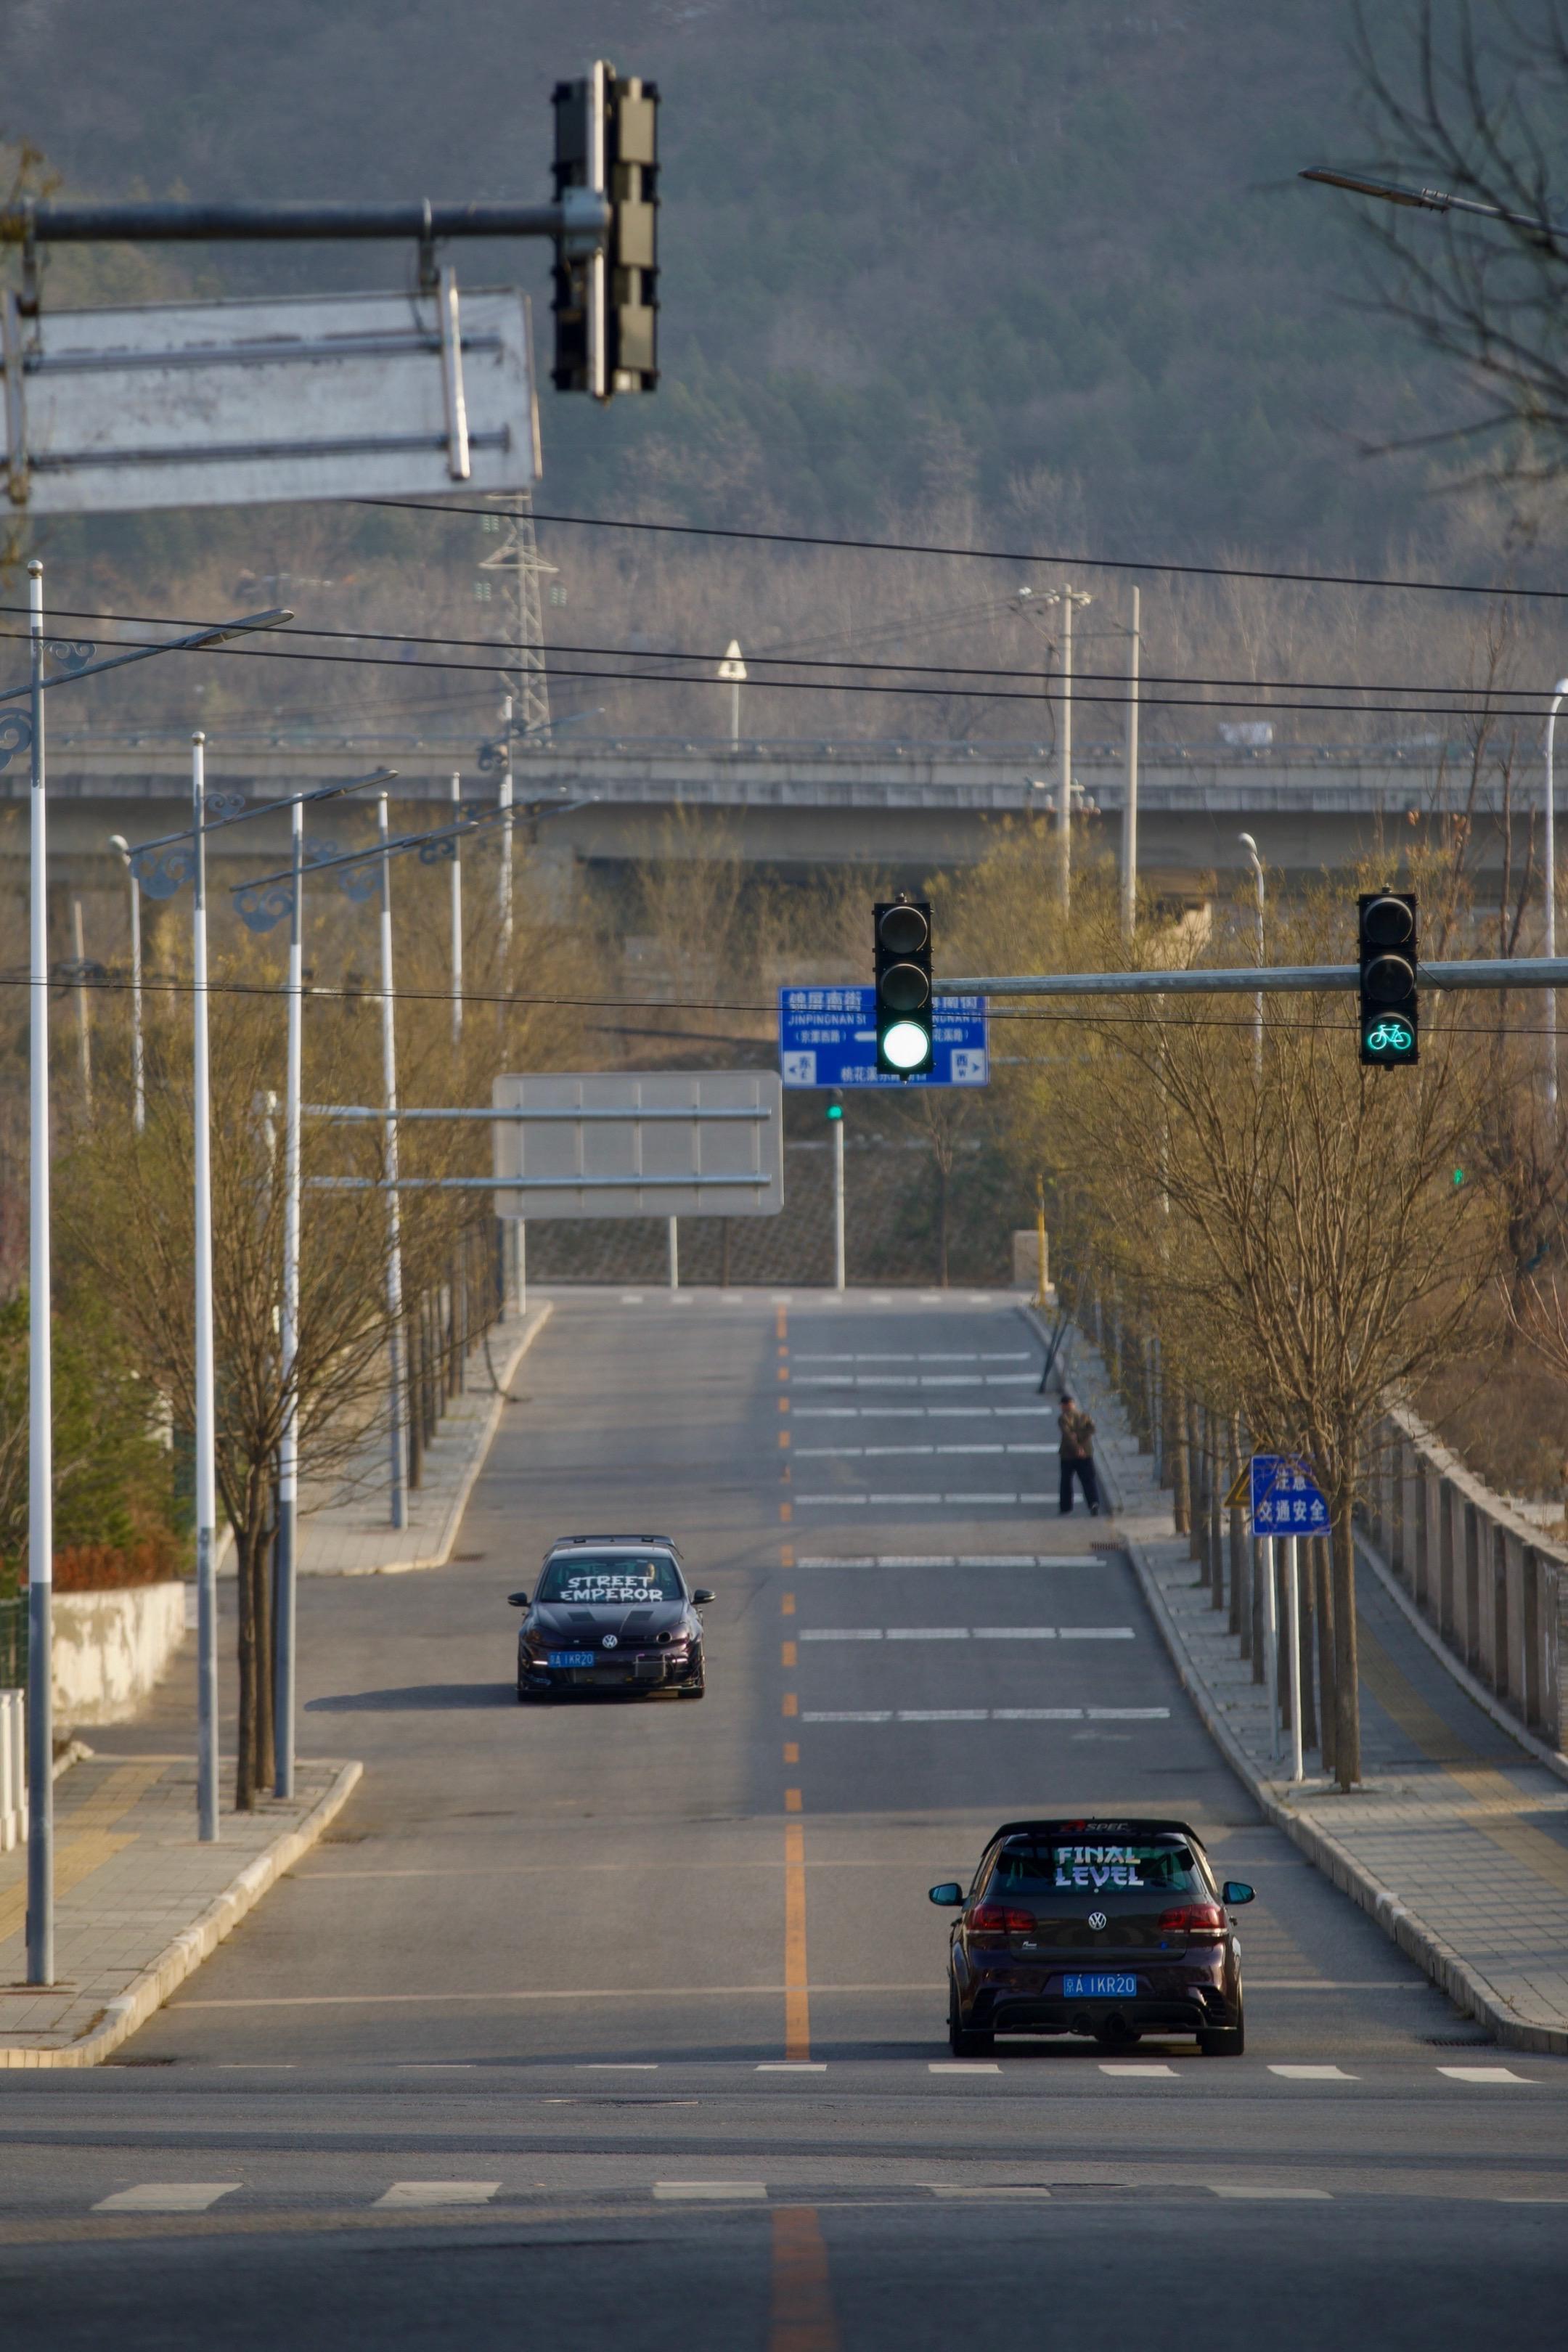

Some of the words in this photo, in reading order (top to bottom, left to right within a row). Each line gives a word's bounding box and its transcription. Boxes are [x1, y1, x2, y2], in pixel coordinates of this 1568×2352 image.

[956, 1053, 968, 1066] 西
[1259, 1498, 1325, 1522] 交通安全
[568, 1575, 653, 1589] STREET
[560, 1588, 663, 1603] EMPEROR
[1057, 1845, 1141, 1865] FINAL
[1055, 1866, 1144, 1887] LEVEL
